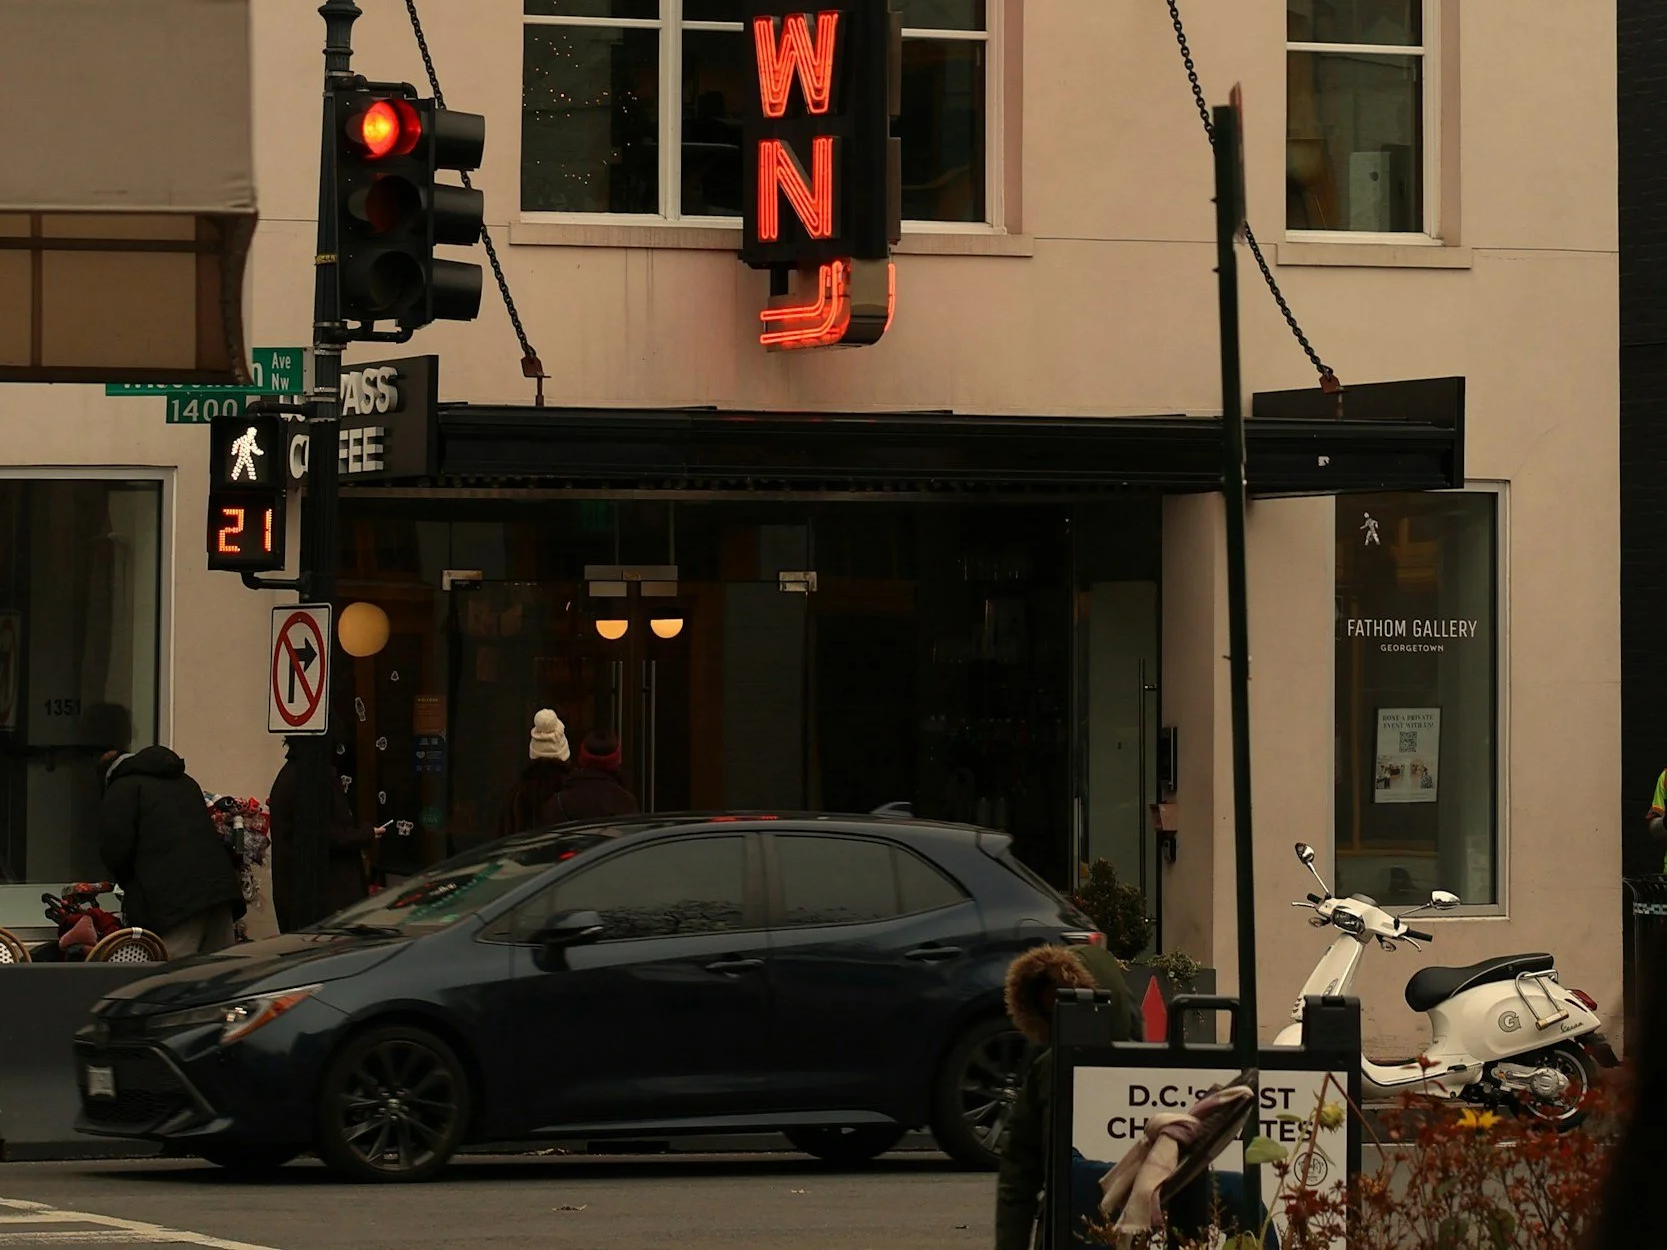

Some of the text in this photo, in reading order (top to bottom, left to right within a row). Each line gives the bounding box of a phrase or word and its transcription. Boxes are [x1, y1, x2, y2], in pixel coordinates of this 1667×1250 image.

[272, 352, 291, 369] Ave
[272, 373, 290, 391] Nw
[171, 399, 238, 422] 1400
[219, 508, 272, 552] 21
[1347, 619, 1477, 638] FATHOM GALLERY
[1380, 644, 1444, 652] GEORGETOWN
[45, 698, 82, 716] 1351
